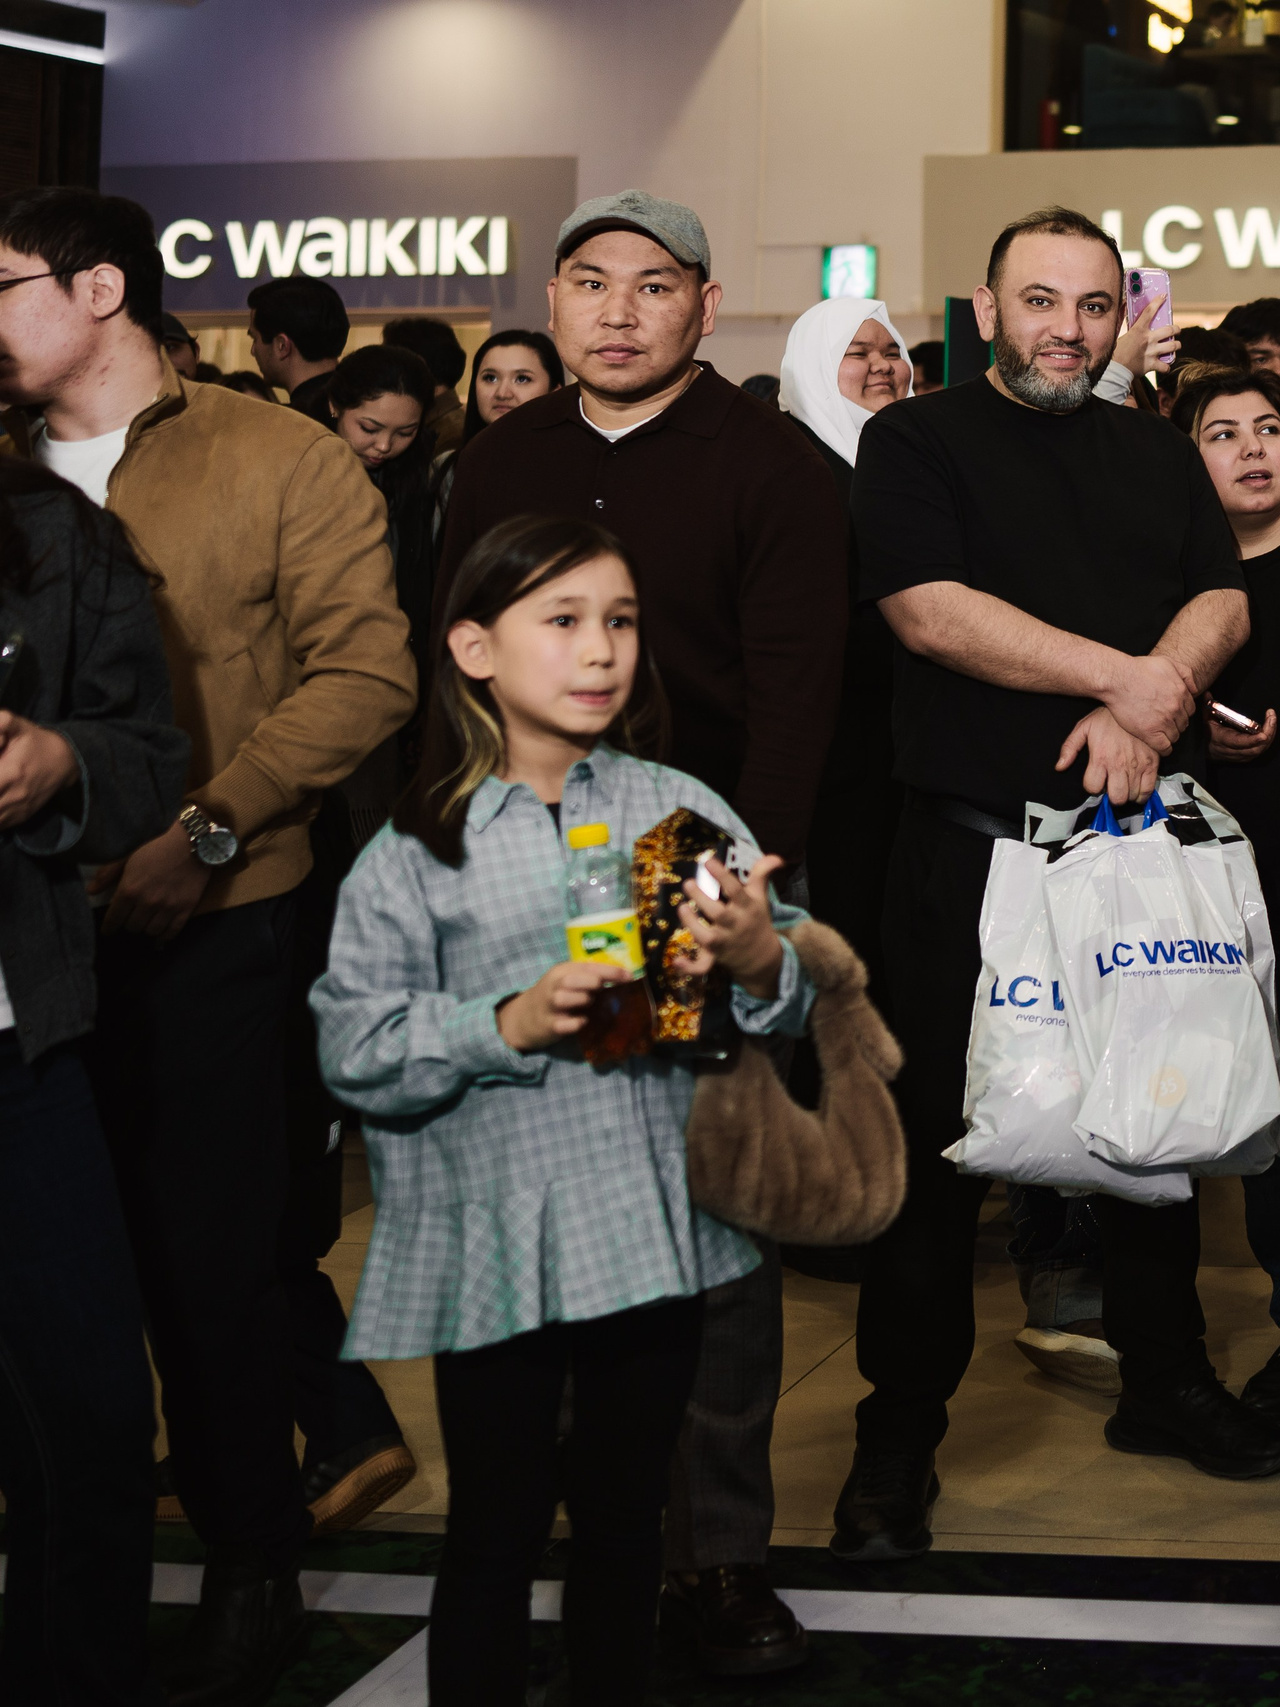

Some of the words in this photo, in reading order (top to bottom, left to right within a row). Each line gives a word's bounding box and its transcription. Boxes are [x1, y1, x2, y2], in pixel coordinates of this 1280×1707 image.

[157, 218, 213, 279] C
[1101, 205, 1203, 269] LC
[1095, 942, 1135, 978] LC
[1123, 968, 1161, 979] everyone
[1163, 966, 1198, 976] deserves
[1199, 967, 1206, 975] to
[1207, 965, 1226, 975] dress
[1227, 966, 1241, 975] well
[989, 974, 1042, 1008] LC
[1016, 1013, 1066, 1027] everyone
